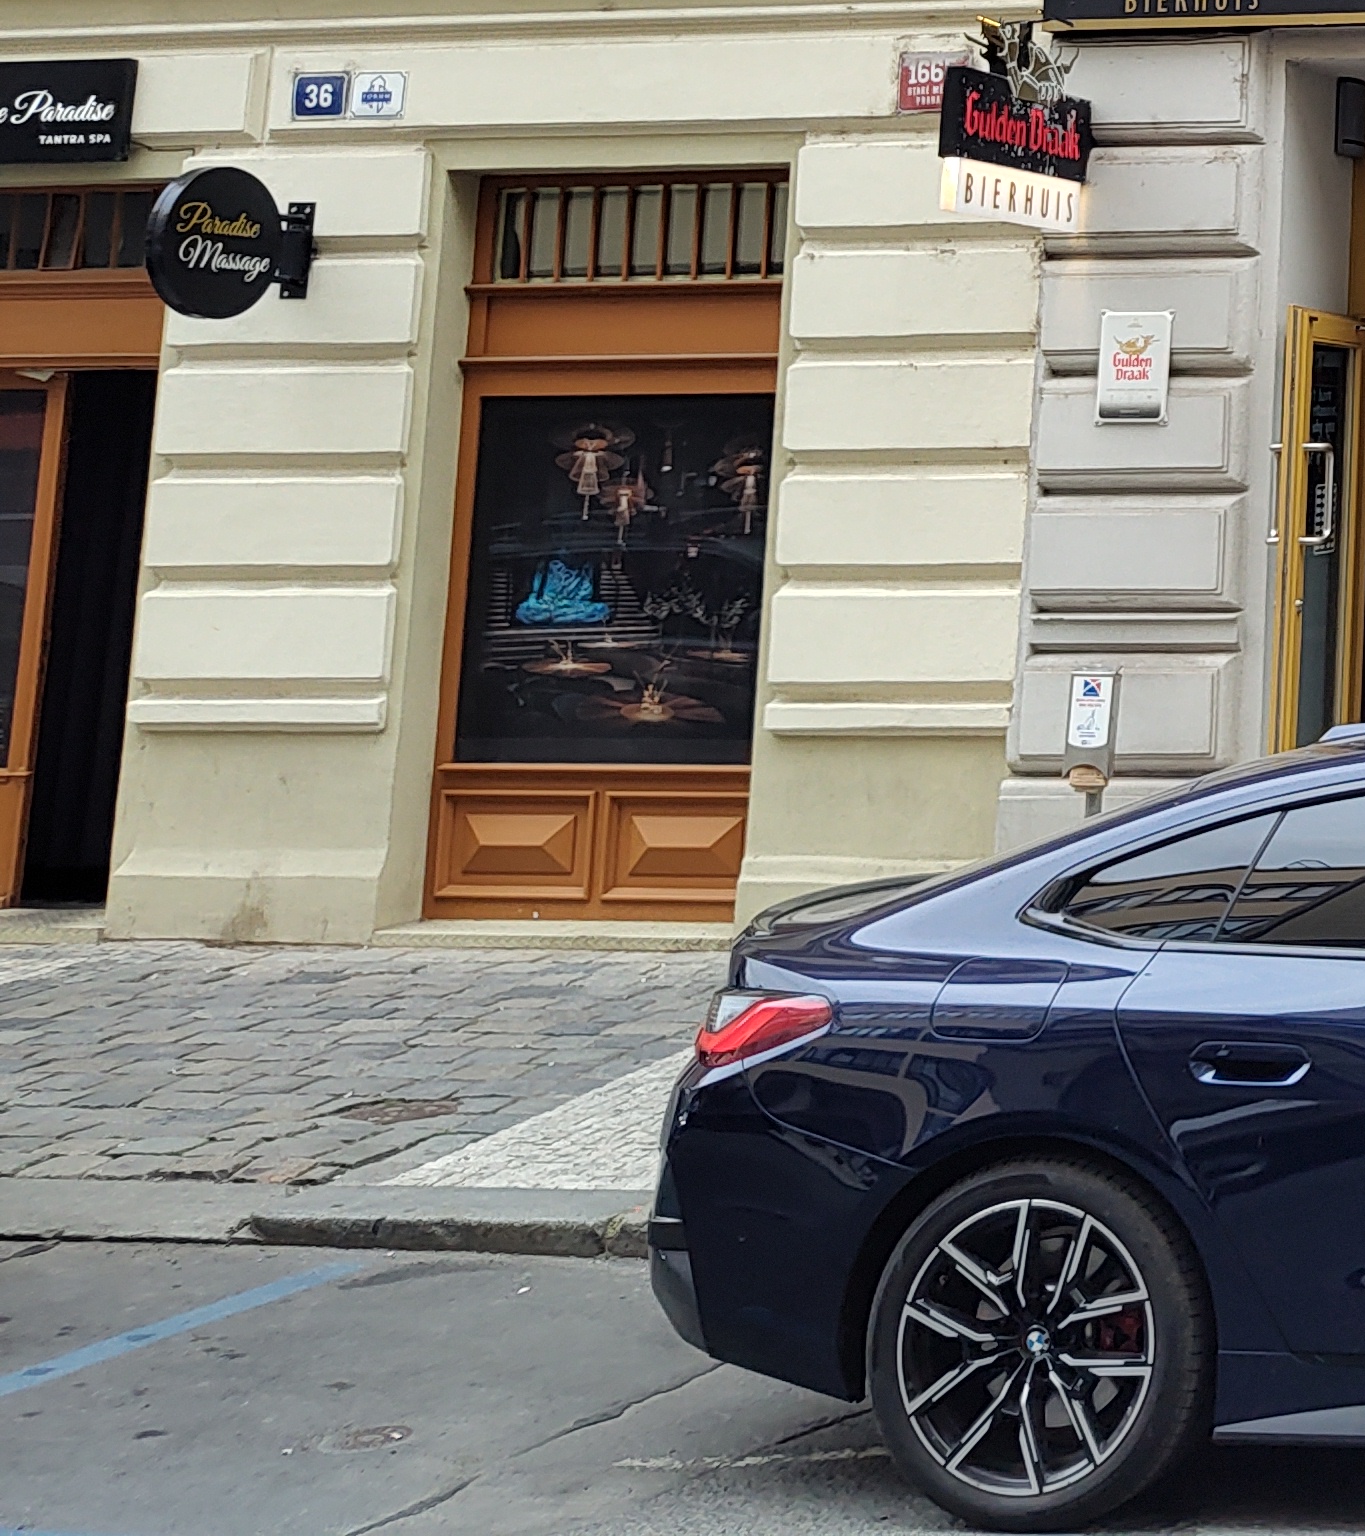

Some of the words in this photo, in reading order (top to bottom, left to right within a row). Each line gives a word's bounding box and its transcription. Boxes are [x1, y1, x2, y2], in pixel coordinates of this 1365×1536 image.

[10, 89, 115, 124] Paradise
[304, 83, 334, 109] 36
[38, 134, 85, 145] TANTRA
[88, 133, 112, 144] SPA
[964, 90, 1027, 148] Gulden
[1029, 108, 1081, 161] Draak
[964, 172, 1074, 223] BIERHUIS
[176, 201, 261, 239] Paradise
[178, 234, 271, 283] Massage
[1112, 352, 1153, 368] Gulden
[1115, 368, 1150, 381] Draak
